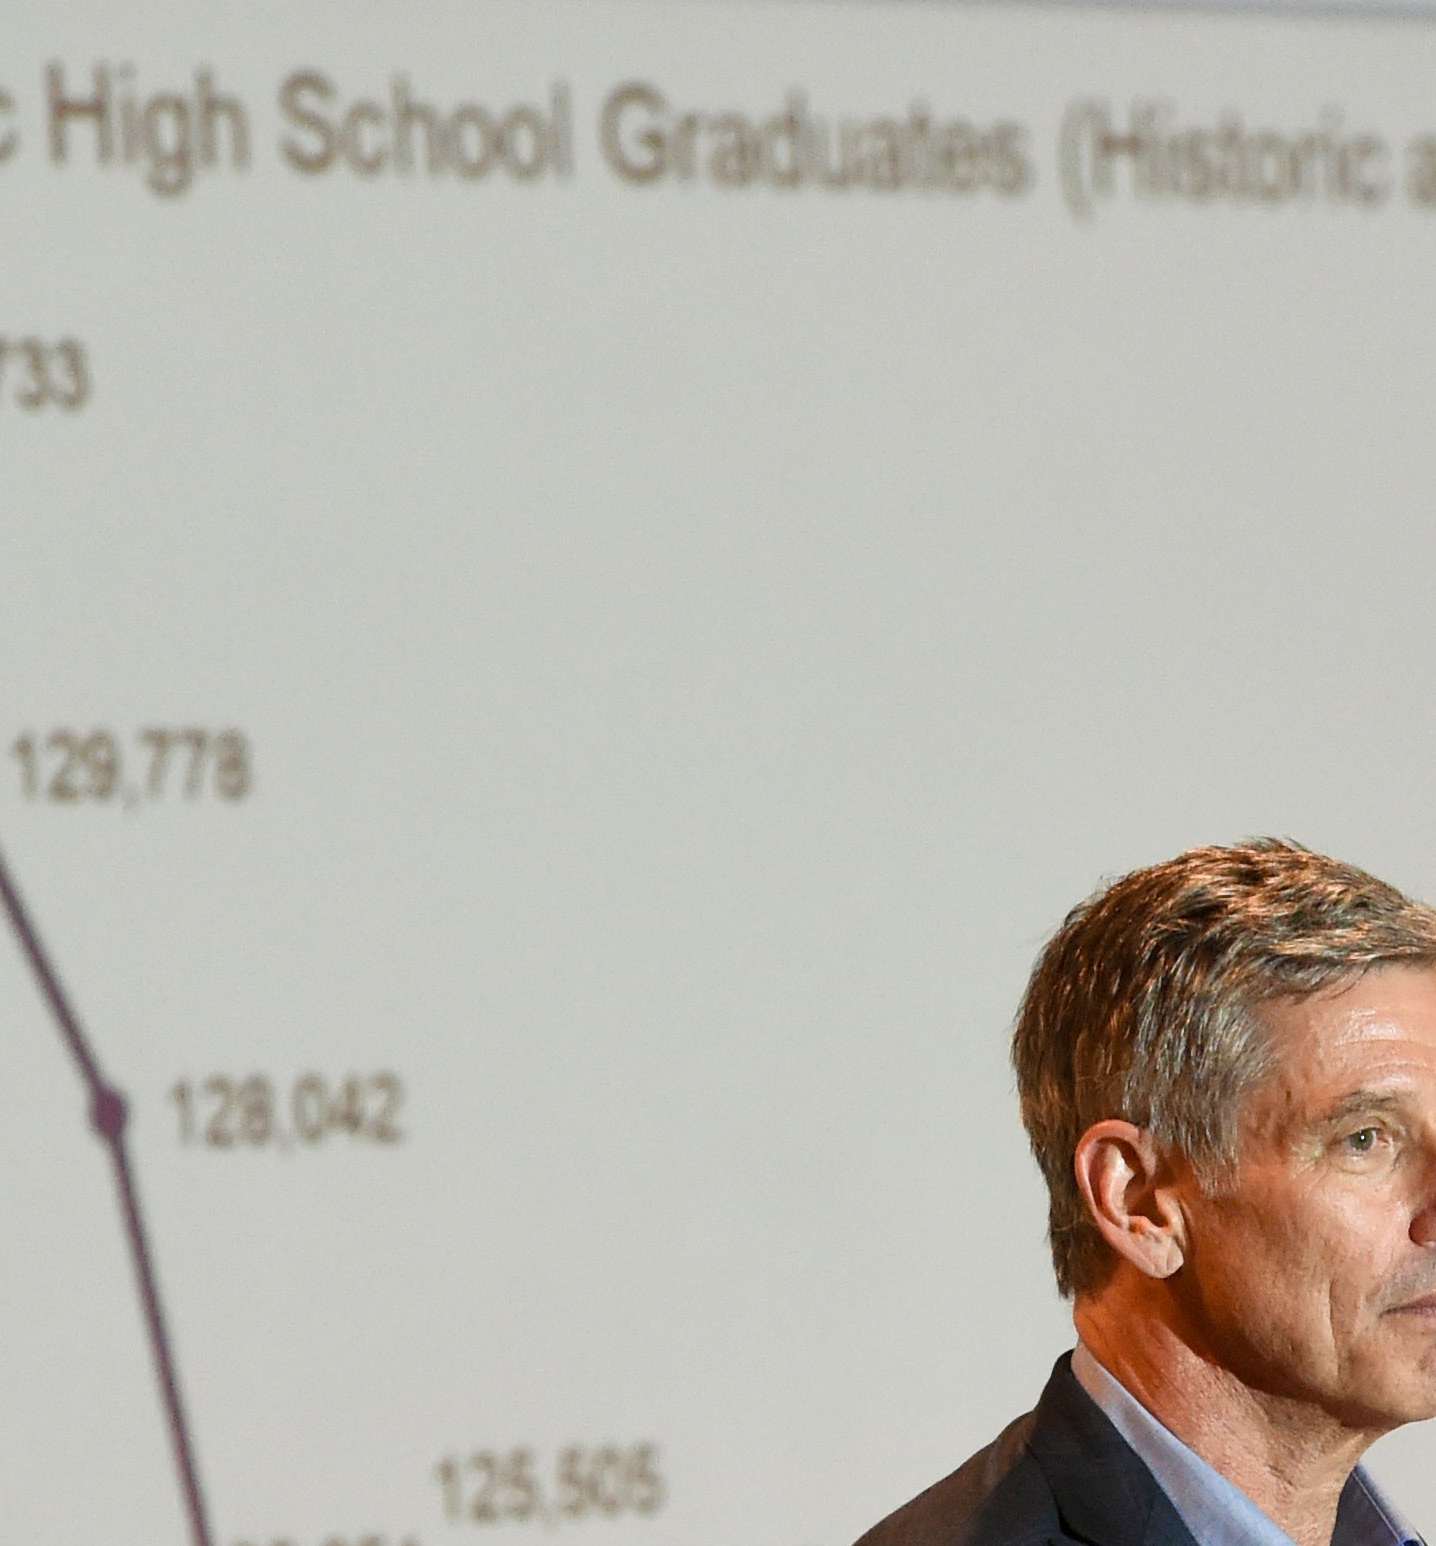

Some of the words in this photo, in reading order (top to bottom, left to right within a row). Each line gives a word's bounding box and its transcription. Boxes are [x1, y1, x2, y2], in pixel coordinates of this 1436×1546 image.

[43, 60, 252, 202] High
[276, 66, 574, 185] School
[597, 78, 1035, 200] Graduates
[1057, 98, 1392, 219] (Historic
[9, 725, 254, 808] 129,778
[168, 1070, 405, 1152] 128,042
[434, 1441, 667, 1527] 125,505
